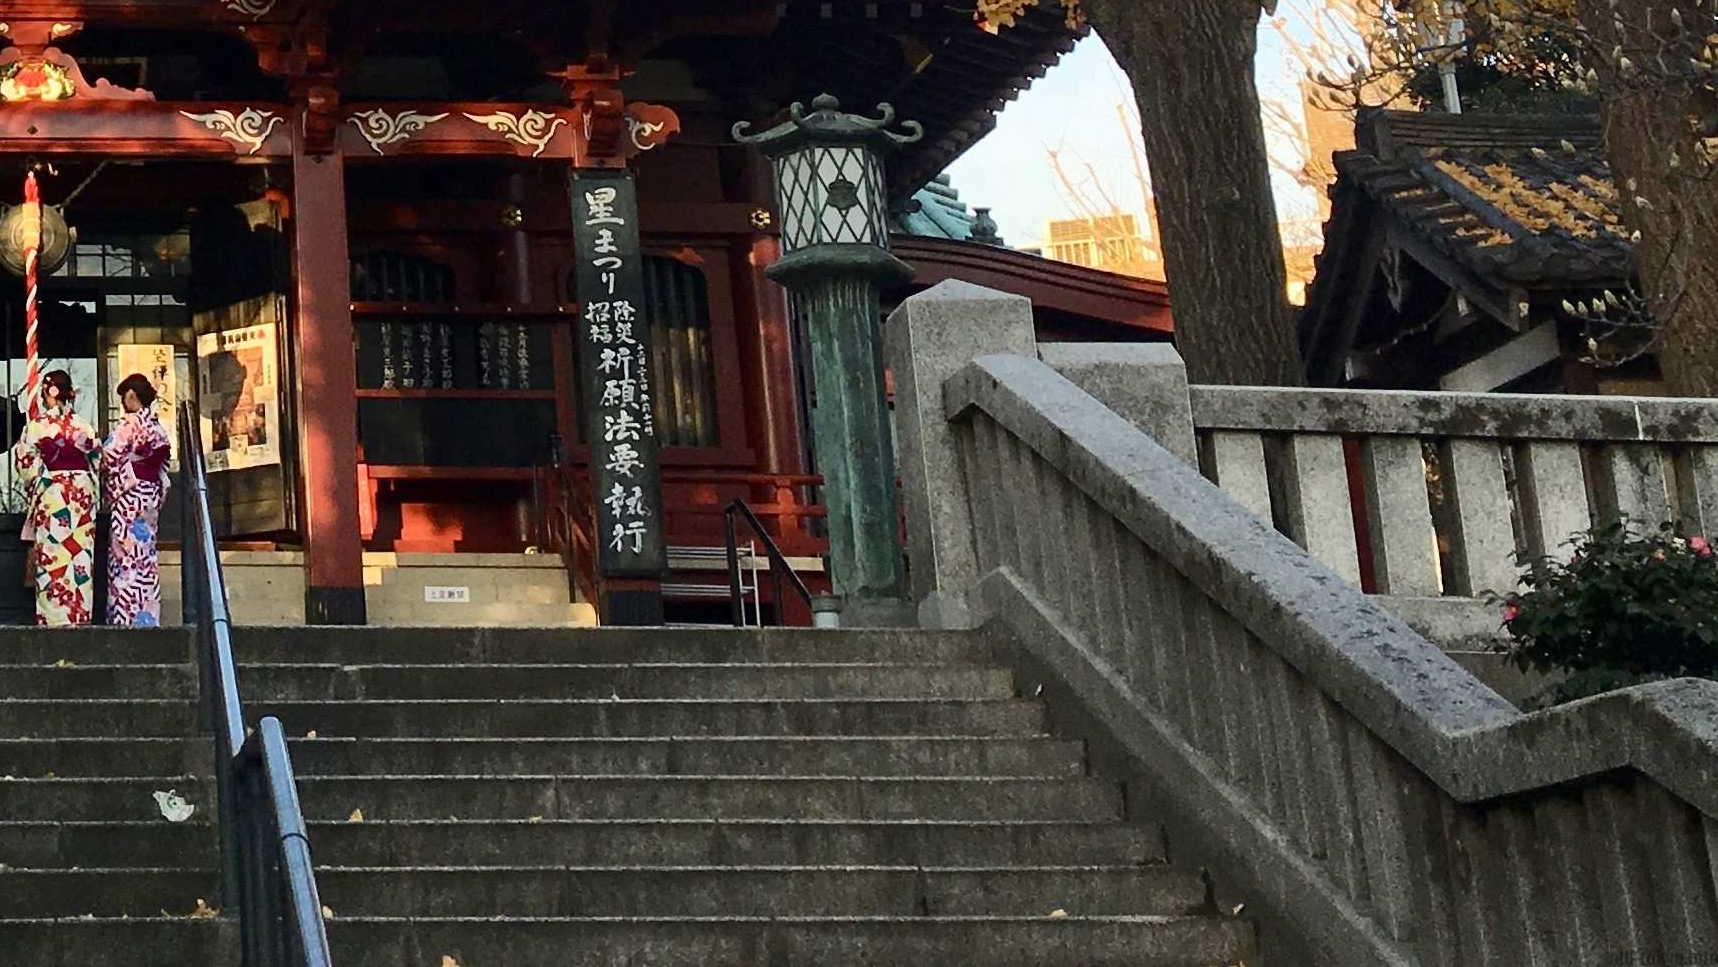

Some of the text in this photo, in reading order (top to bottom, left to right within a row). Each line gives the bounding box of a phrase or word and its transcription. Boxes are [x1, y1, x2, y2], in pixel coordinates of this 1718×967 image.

[585, 187, 625, 294] 星まつり
[597, 347, 651, 553] 祈願法要執行
